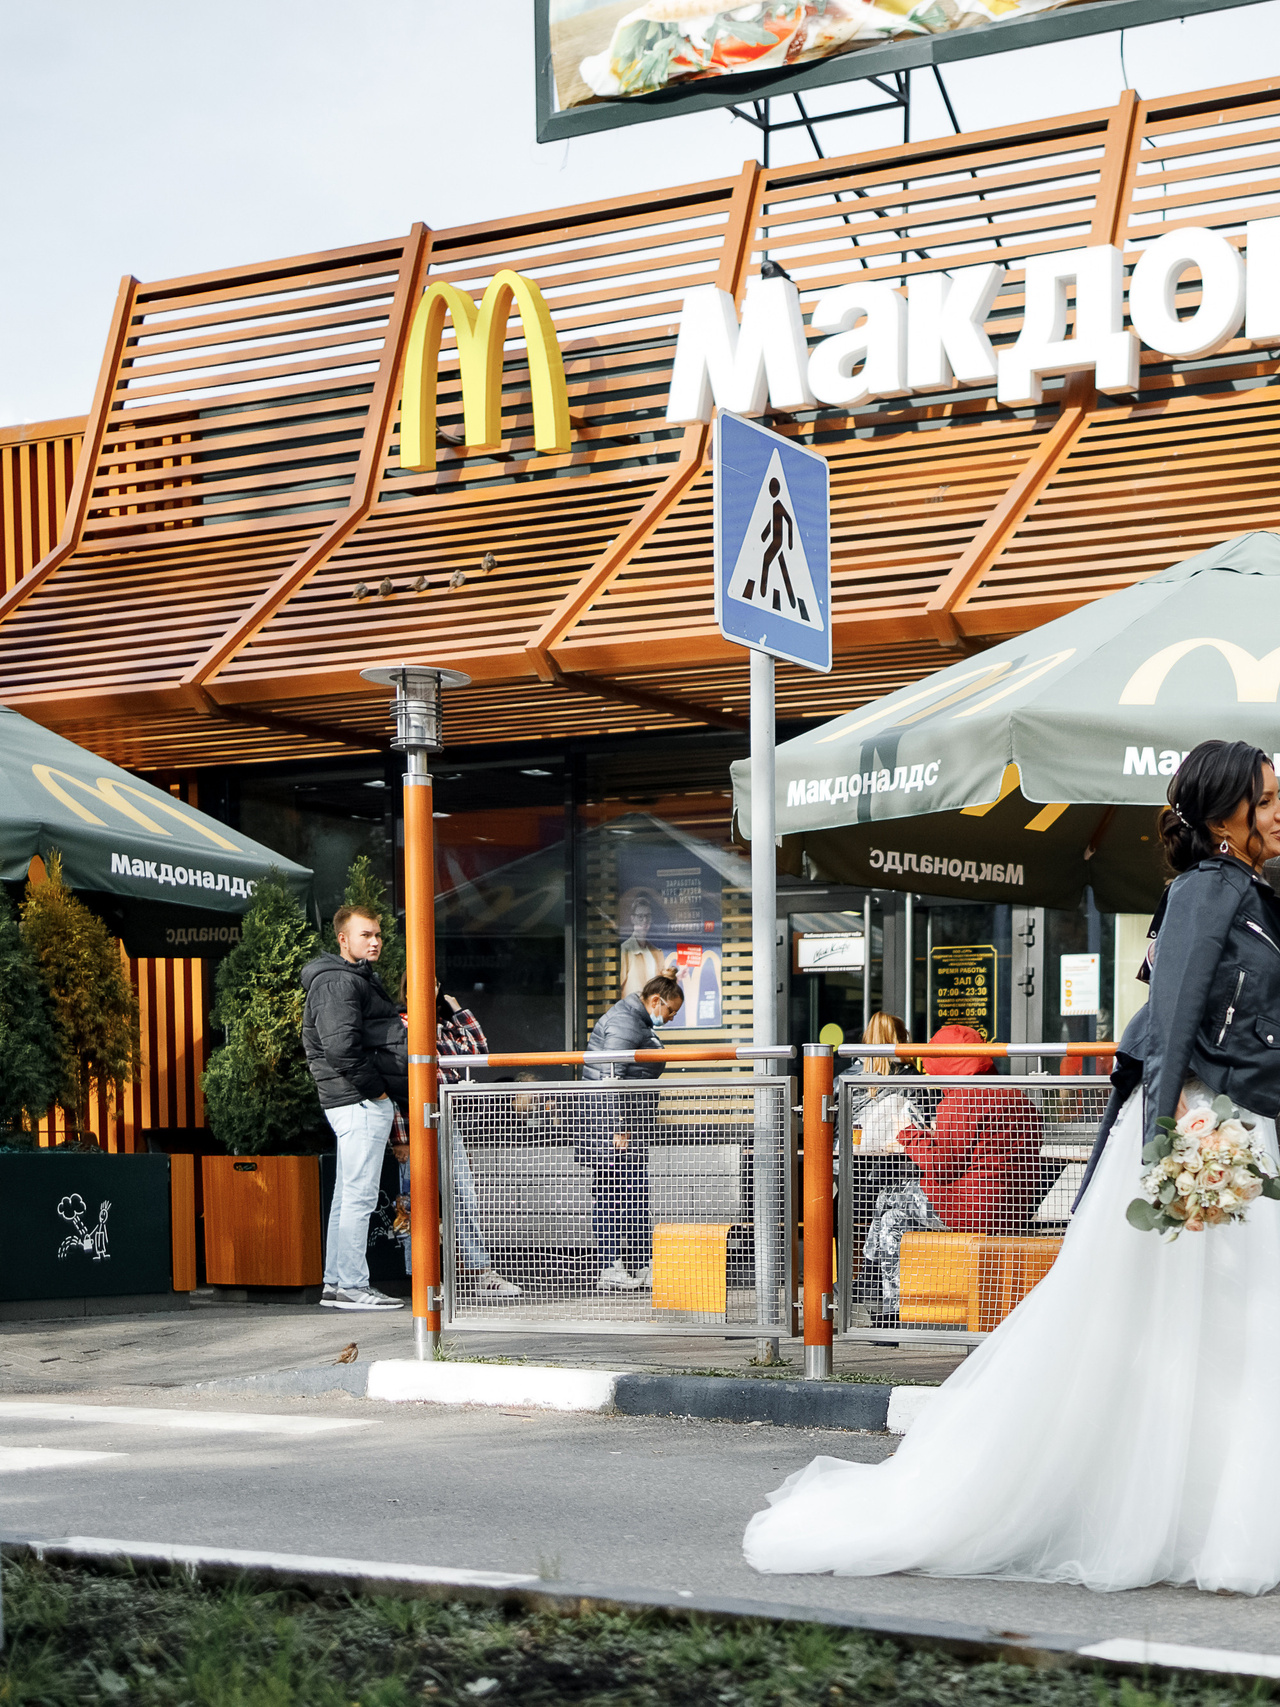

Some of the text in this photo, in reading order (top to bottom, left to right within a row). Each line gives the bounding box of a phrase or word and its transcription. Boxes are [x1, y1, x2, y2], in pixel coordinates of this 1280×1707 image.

[786, 760, 940, 808] Макдоналдс
[111, 852, 258, 899] Макдоналдс
[953, 976, 972, 986] ЗАЛ
[938, 988, 959, 997] 07:00
[965, 987, 988, 996] 23:30
[938, 1009, 959, 1017] 04:00
[965, 1008, 987, 1016] 05:00
